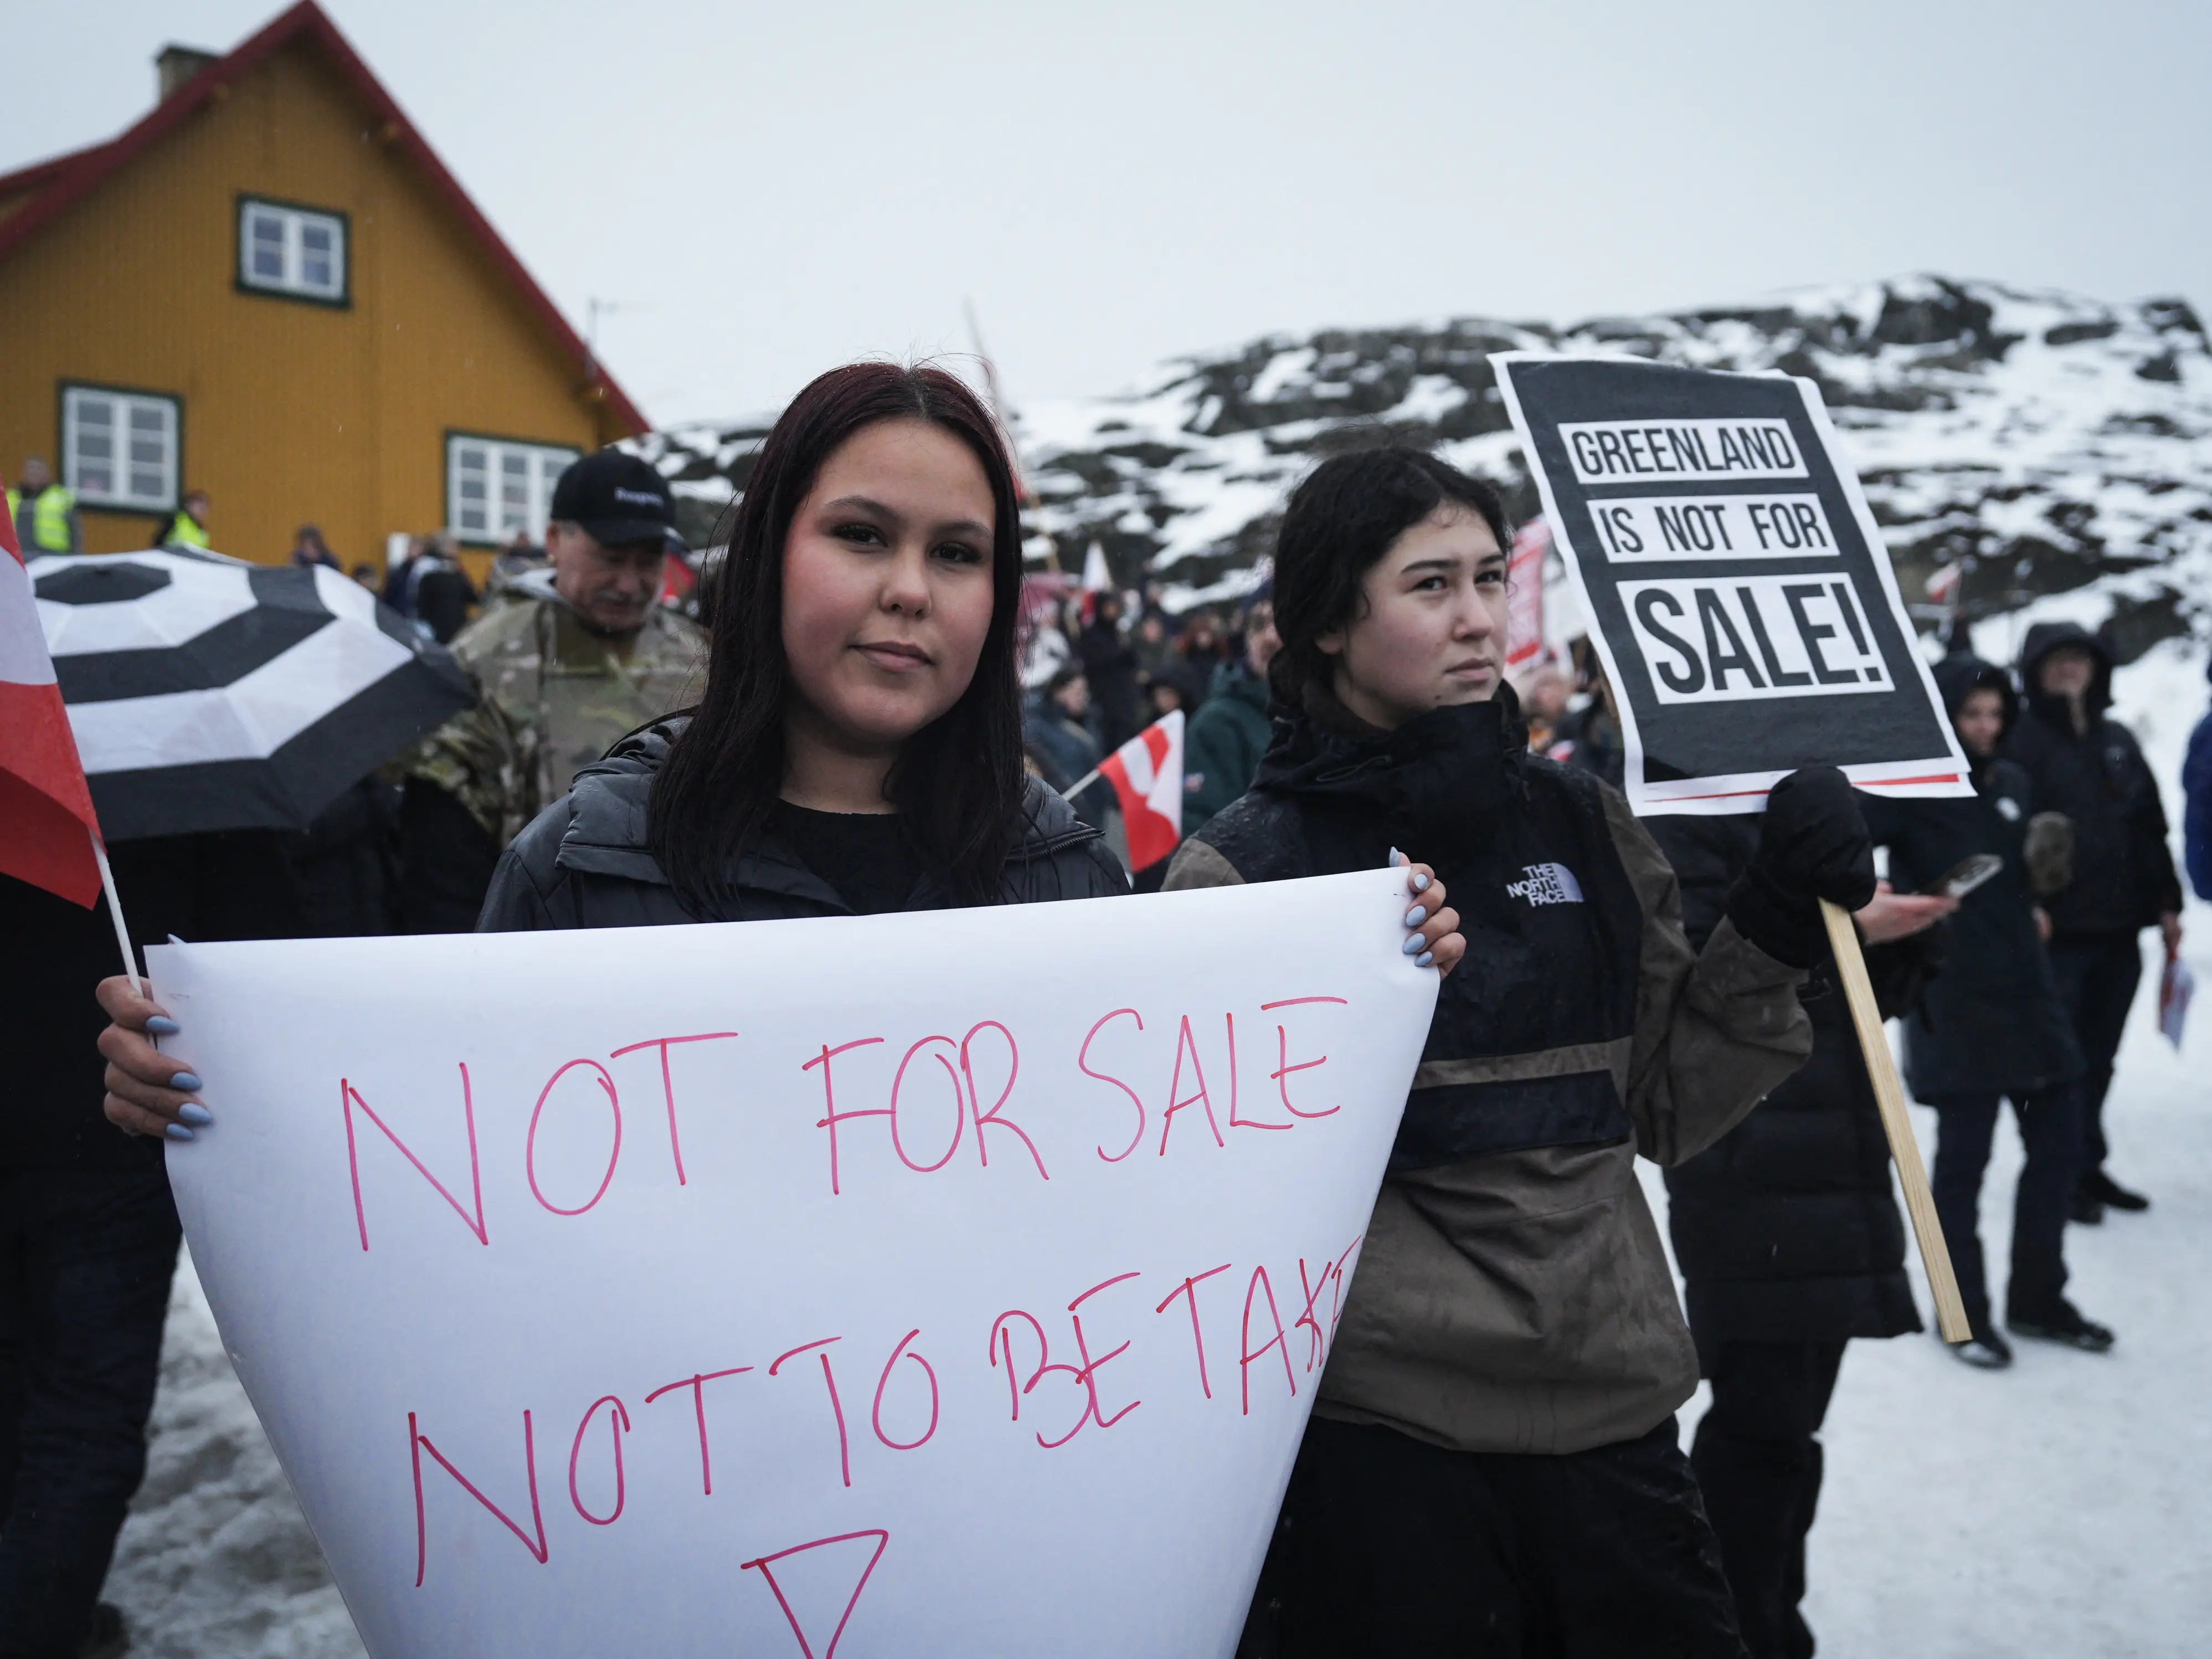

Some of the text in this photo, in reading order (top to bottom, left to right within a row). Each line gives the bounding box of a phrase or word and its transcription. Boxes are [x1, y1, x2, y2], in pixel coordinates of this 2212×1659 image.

[1571, 427, 1796, 476] GREENLAND
[1598, 502, 1829, 554] IS NOT FOR
[1633, 582, 1882, 695] SALE!
[1505, 876, 1562, 898] NORTH
[1521, 863, 1557, 879] THE
[1527, 889, 1565, 907] FACE
[341, 997, 1348, 1252] NOT FOR SALE
[408, 1365, 754, 1588] NOT
[769, 1328, 939, 1487] TO
[989, 1271, 1141, 1449] BE
